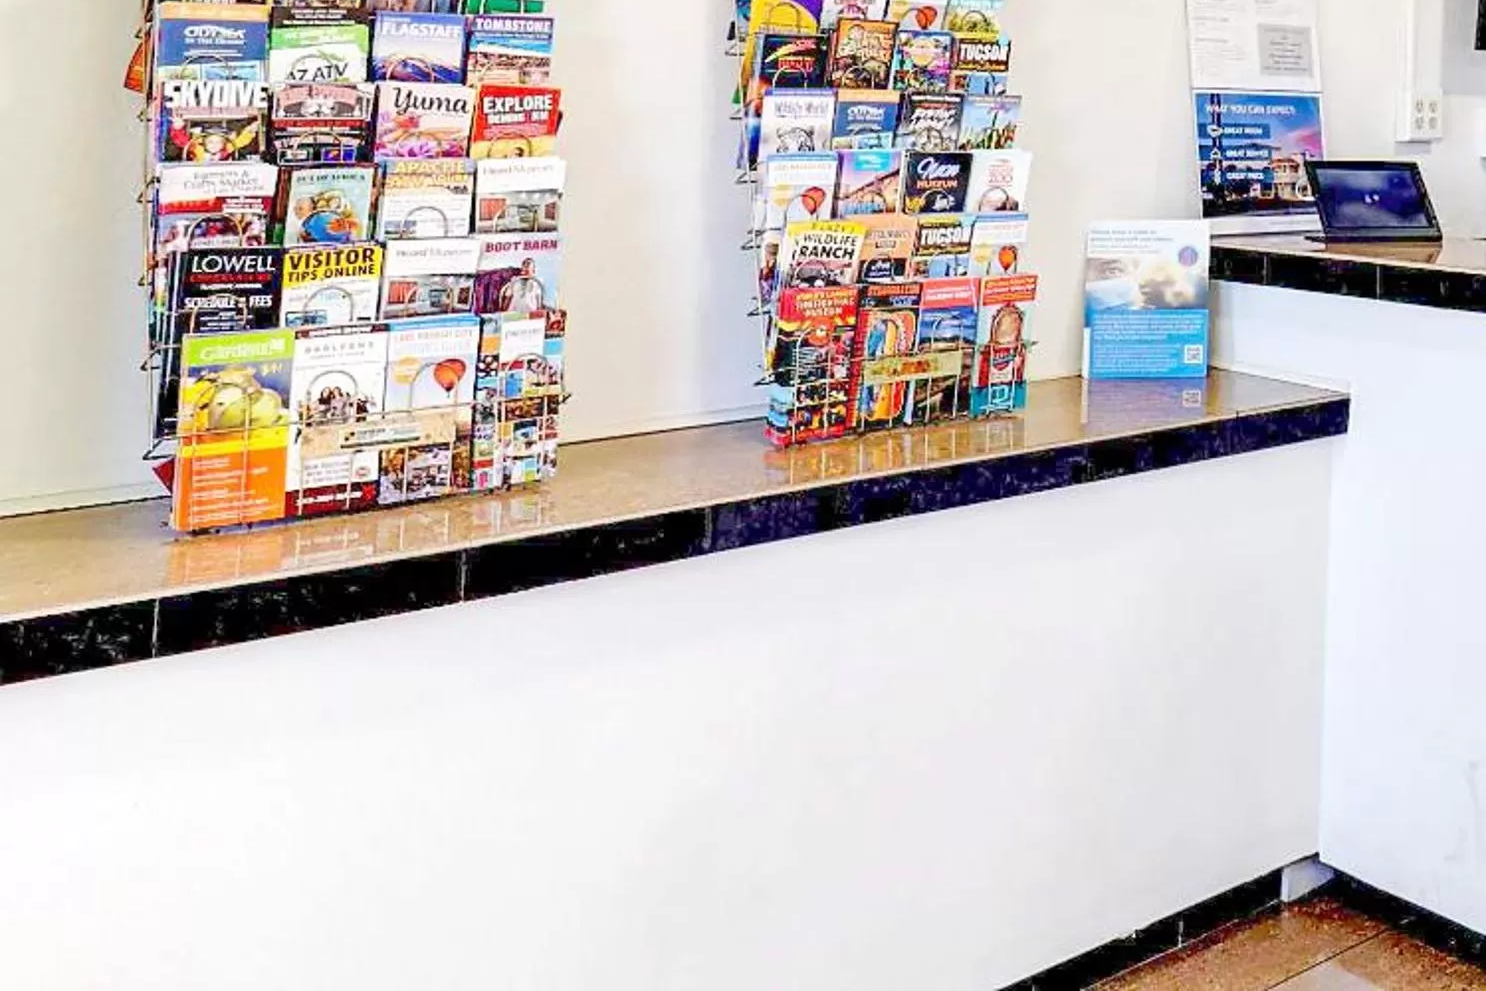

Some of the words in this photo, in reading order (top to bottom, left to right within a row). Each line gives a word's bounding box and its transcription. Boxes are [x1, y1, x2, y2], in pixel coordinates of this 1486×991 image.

[382, 22, 462, 39] FLAGSTAFF
[475, 18, 551, 32] TOMBSTONE
[960, 42, 1009, 62] TUCSON
[312, 63, 349, 82] ATV
[163, 80, 269, 110] SKYDIVE
[392, 86, 470, 115] Yuma
[483, 94, 552, 114] EXPLORE
[803, 232, 858, 247] WILDLIFE
[921, 225, 971, 246] TUCSON
[485, 241, 521, 254] BOOT
[523, 239, 558, 252] BARN
[799, 246, 855, 260] RANCH
[191, 255, 277, 274] LOWELL
[288, 247, 375, 271] VISITOR
[287, 270, 318, 283] TIPS
[323, 263, 375, 280] ONLINE
[249, 295, 273, 308] FEES
